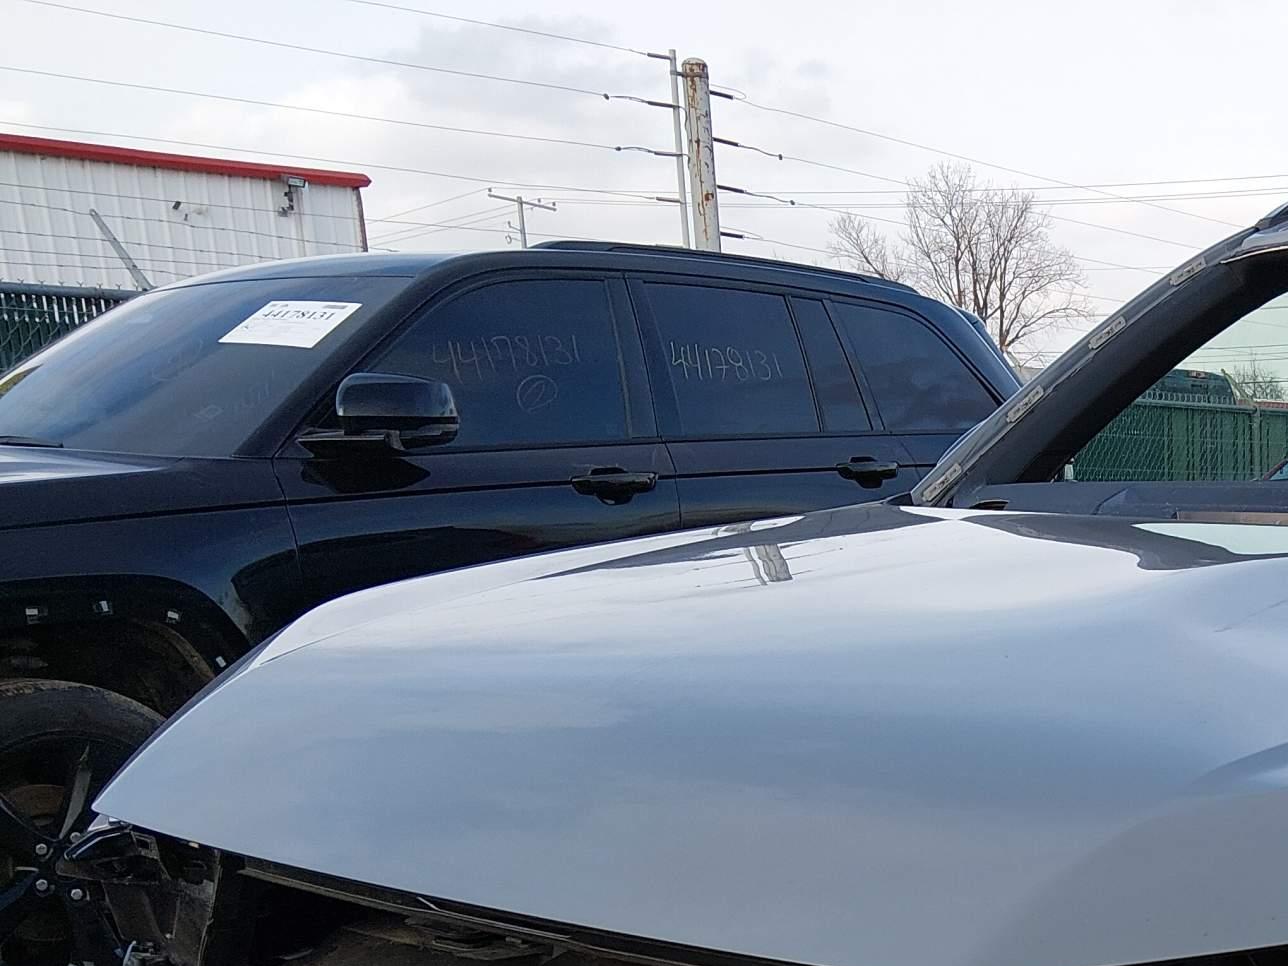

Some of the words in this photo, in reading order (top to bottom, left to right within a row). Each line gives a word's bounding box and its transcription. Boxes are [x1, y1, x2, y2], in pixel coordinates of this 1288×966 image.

[262, 309, 337, 321] 44178131
[432, 334, 582, 384] 44178131
[669, 340, 784, 382] 44178131
